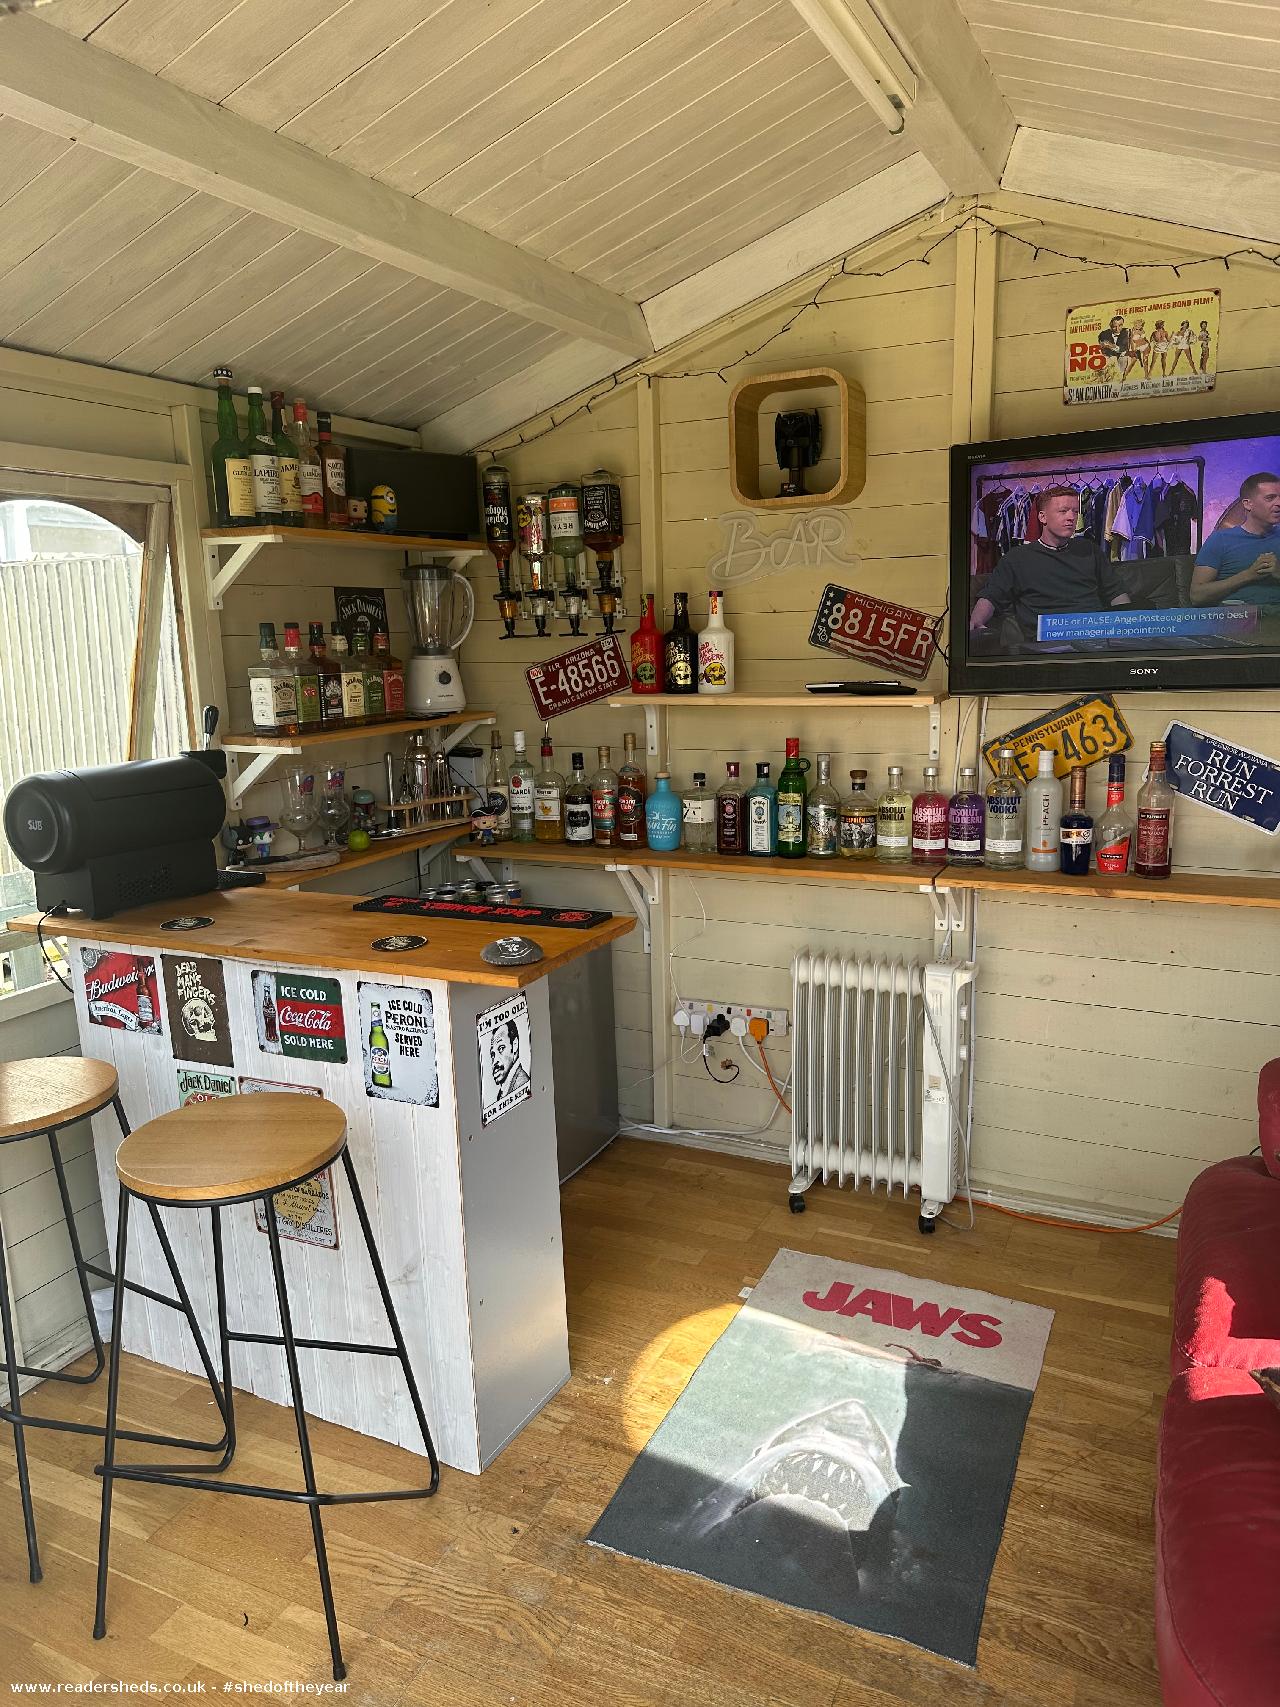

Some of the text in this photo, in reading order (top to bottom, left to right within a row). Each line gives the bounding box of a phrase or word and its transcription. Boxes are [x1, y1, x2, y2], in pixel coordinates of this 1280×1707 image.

[1129, 306, 1147, 314] FIRST
[1148, 302, 1171, 311] JAMES
[1172, 299, 1192, 308] BOND
[1069, 355, 1106, 372] NO
[711, 515, 855, 580] BAR
[854, 597, 913, 621] MICHIGAN
[1046, 618, 1069, 626] TRUE
[1114, 615, 1138, 625] Ange
[1226, 610, 1249, 619] best
[827, 602, 933, 658] 8815FR
[1065, 626, 1115, 637] managerial
[1116, 624, 1177, 636] appointment
[565, 648, 596, 665] ARIZONA
[534, 650, 621, 705] E-48566
[1129, 668, 1159, 676] SONY
[548, 697, 571, 711] GRAND
[598, 679, 618, 692] STATE
[1012, 711, 1085, 751] PENNSYLVANIA
[1206, 748, 1258, 780] RUN
[1174, 754, 1274, 805] FORREST
[987, 796, 1021, 805] ABSOLUT
[1188, 779, 1240, 811] RUN
[914, 807, 945, 815] ABSOLUT
[990, 805, 1018, 814] VODKA
[27, 820, 43, 830] SUB
[175, 961, 197, 976] DEAD
[177, 972, 202, 987] MAN'S
[177, 985, 217, 1006] FINGERS
[280, 986, 327, 1001] ICE COLD
[387, 1000, 423, 1014] ICE COLD
[384, 1010, 428, 1028] PERONI
[479, 1001, 526, 1032] I'M TOO OLD
[284, 1034, 334, 1050] SOLD HERE
[394, 1032, 423, 1047] SERVED
[400, 1044, 420, 1058] HERE
[180, 1072, 232, 1094] Jack Daniel
[483, 1107, 497, 1120] FOR
[498, 1096, 514, 1110] THIS
[802, 1281, 1004, 1349] JAWS
